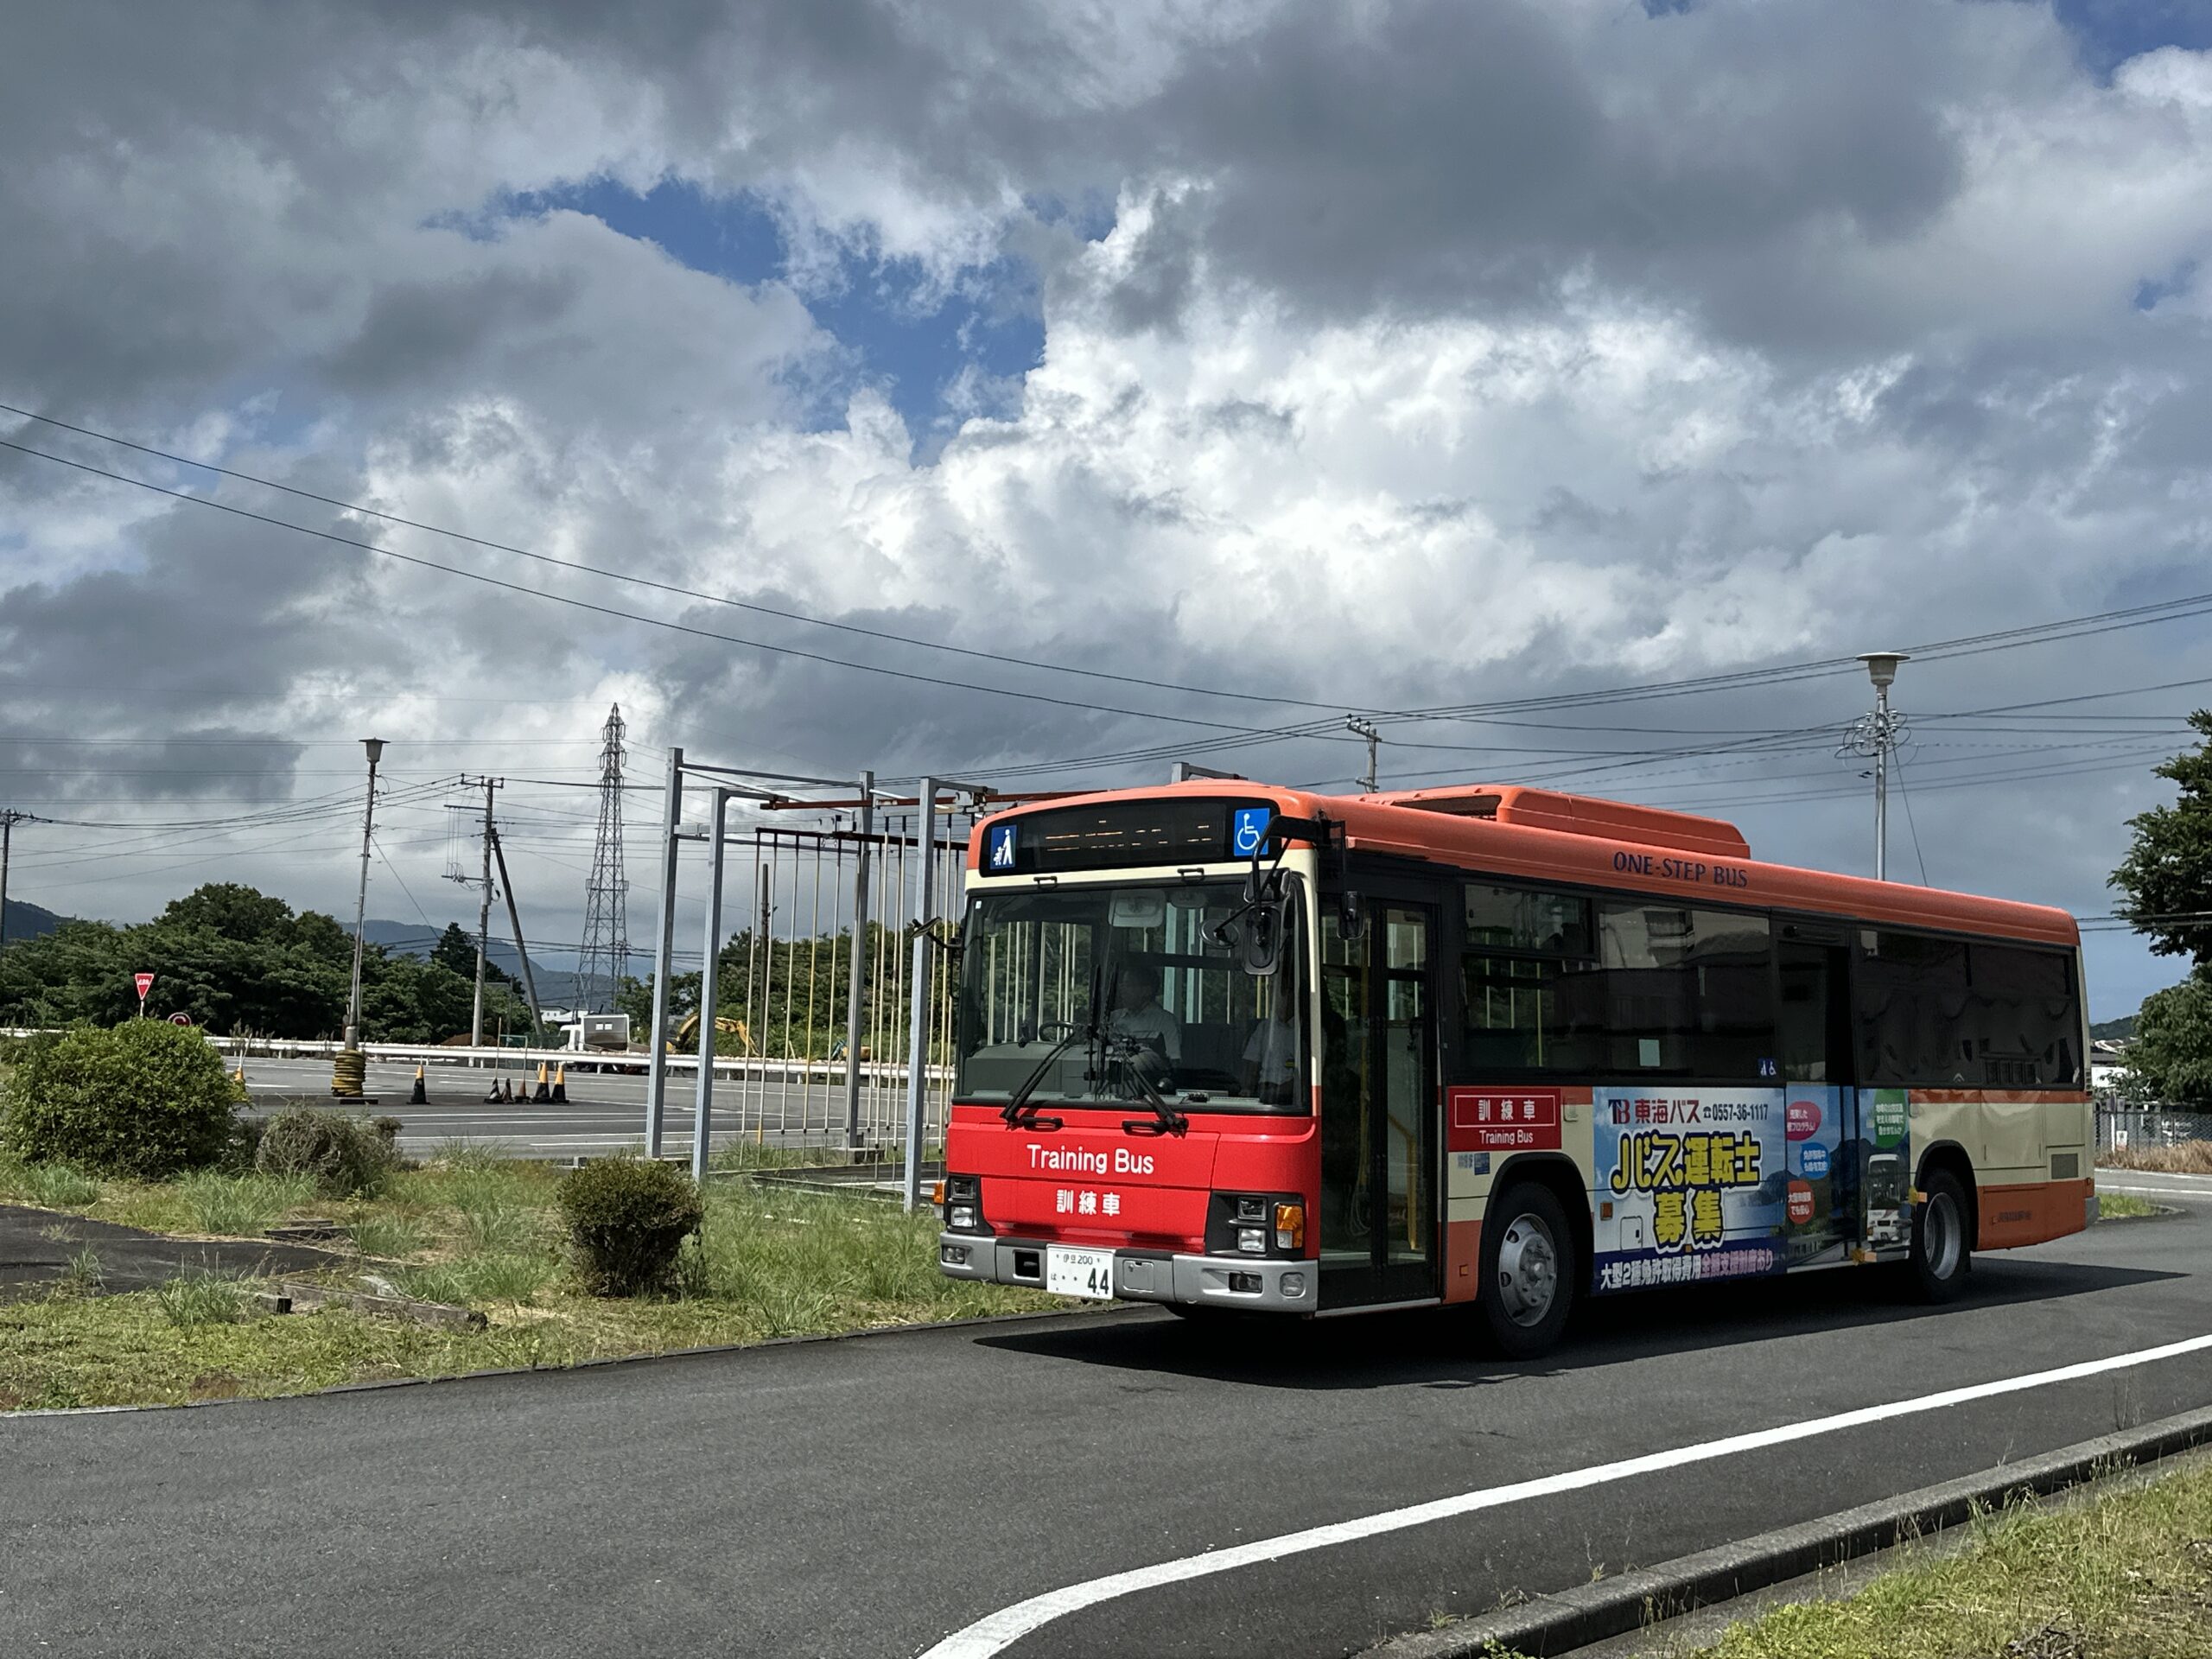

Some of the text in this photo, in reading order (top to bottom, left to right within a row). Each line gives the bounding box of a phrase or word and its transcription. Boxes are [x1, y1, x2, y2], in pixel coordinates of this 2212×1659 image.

[1613, 851, 1747, 887] ONE-STEP BUS
[1478, 1099, 1535, 1121] 訓練車
[1634, 1099, 1769, 1123] 東海バス 0557-36-1117
[1479, 1128, 1534, 1145] Training Bus
[1027, 1144, 1154, 1174] Training Bus
[1611, 1130, 1760, 1191] バス運転士
[1056, 1189, 1121, 1216] 訓練車
[1655, 1190, 1722, 1244] 募集
[1087, 1267, 1109, 1295] 44
